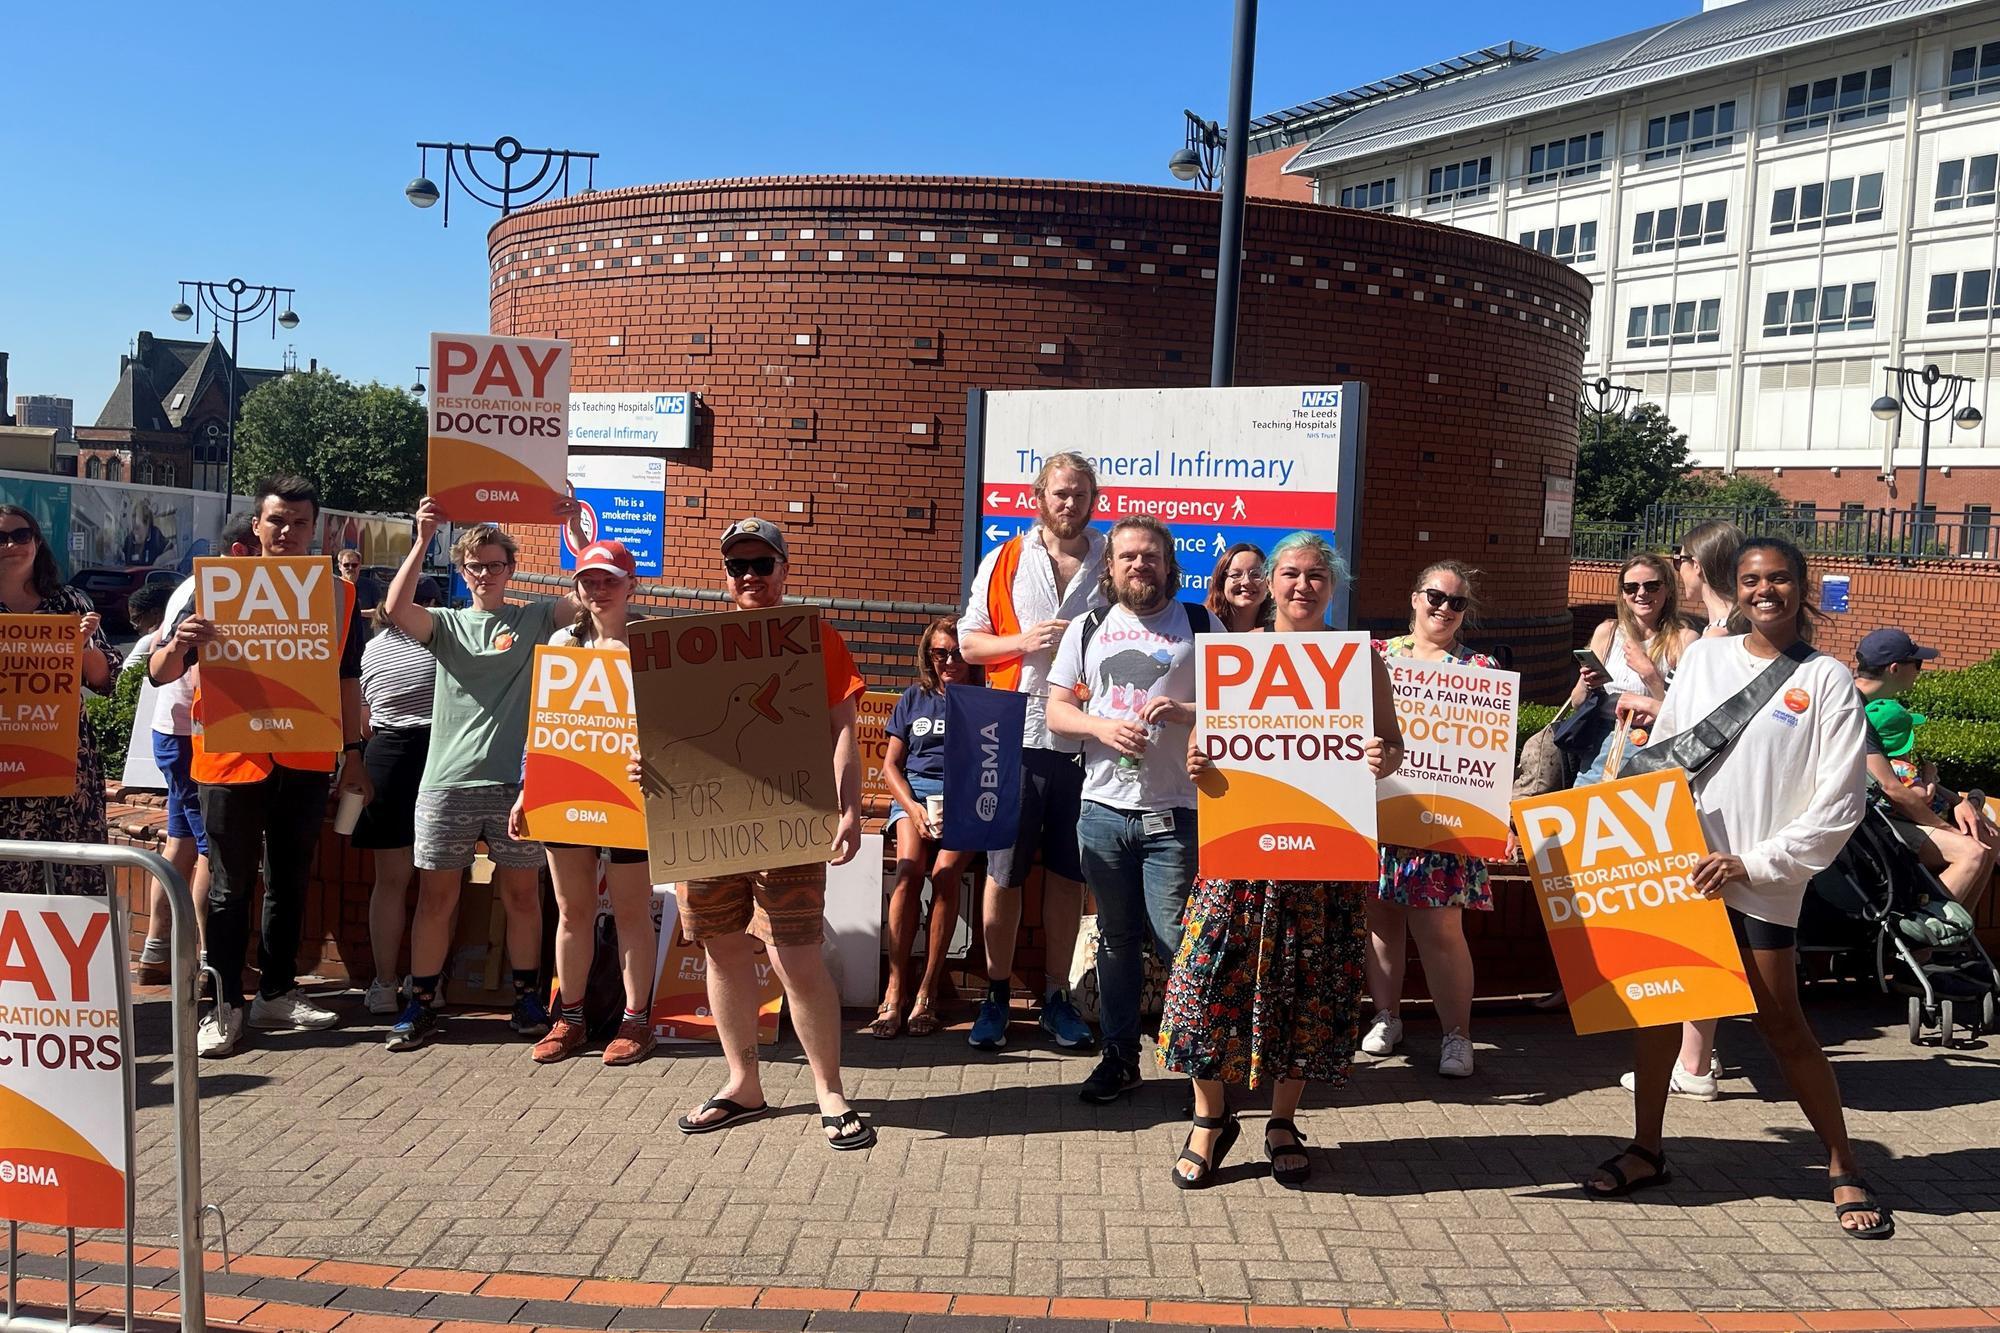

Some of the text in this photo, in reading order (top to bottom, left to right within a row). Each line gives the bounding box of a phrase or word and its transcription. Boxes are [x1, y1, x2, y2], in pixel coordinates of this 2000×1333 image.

[437, 341, 562, 398] PAY
[437, 397, 561, 413] RESTORATION FOR
[568, 397, 684, 414] eds Teaching Hospitals NHS
[1303, 392, 1337, 407] NHS
[1292, 409, 1338, 418] The Leeds
[436, 412, 561, 438] DOCTORS
[576, 426, 611, 438] General
[614, 426, 658, 442] Infirmary
[1252, 420, 1337, 431] Teaching Hospitals
[1016, 449, 1294, 486] Th eneral Infirmary
[490, 490, 519, 502] BMA
[614, 497, 629, 507] This
[631, 497, 637, 507] is
[602, 510, 657, 522] smokefree site
[1098, 495, 1224, 520] & Emergency
[623, 526, 652, 536] completely
[201, 565, 324, 621] PAY
[58, 625, 76, 640] IS
[215, 623, 329, 636] ESTORATION FOR
[31, 642, 75, 655] WAGE
[205, 638, 330, 662] DOCTORS
[628, 614, 822, 673] HONK!
[3, 656, 74, 671] JUNIOR
[1204, 642, 1361, 711] PAY
[1393, 667, 1512, 697] £14/HOUR IS
[1392, 684, 1511, 711] NOT A FAIR WAGE
[17, 704, 60, 721] PAY
[536, 711, 625, 729] RESTORATION
[1205, 714, 1364, 730] RESTORATION FOR
[1429, 703, 1441, 718] A
[1445, 705, 1510, 728] JUNIOR
[32, 722, 59, 731] NOW
[263, 718, 294, 730] BMA
[534, 727, 640, 755] DOCTOR
[1205, 733, 1366, 761] DOCTORS
[980, 722, 999, 788] BMA
[1457, 757, 1497, 778] PAY
[1396, 767, 1495, 789] RESTORATION NOW
[670, 769, 813, 820] FOR YOUR
[578, 809, 608, 824] BMA
[1434, 812, 1463, 828] BMA
[1521, 780, 1677, 875] PAY
[663, 814, 834, 866] JUNIOR DOCS
[1277, 835, 1316, 850] BMA
[1541, 852, 1701, 893] RESTORATION FOR
[0, 910, 110, 1002] AY
[1643, 978, 1685, 998] BMA
[76, 1009, 120, 1029] FOR
[17, 1164, 60, 1187] BMA
